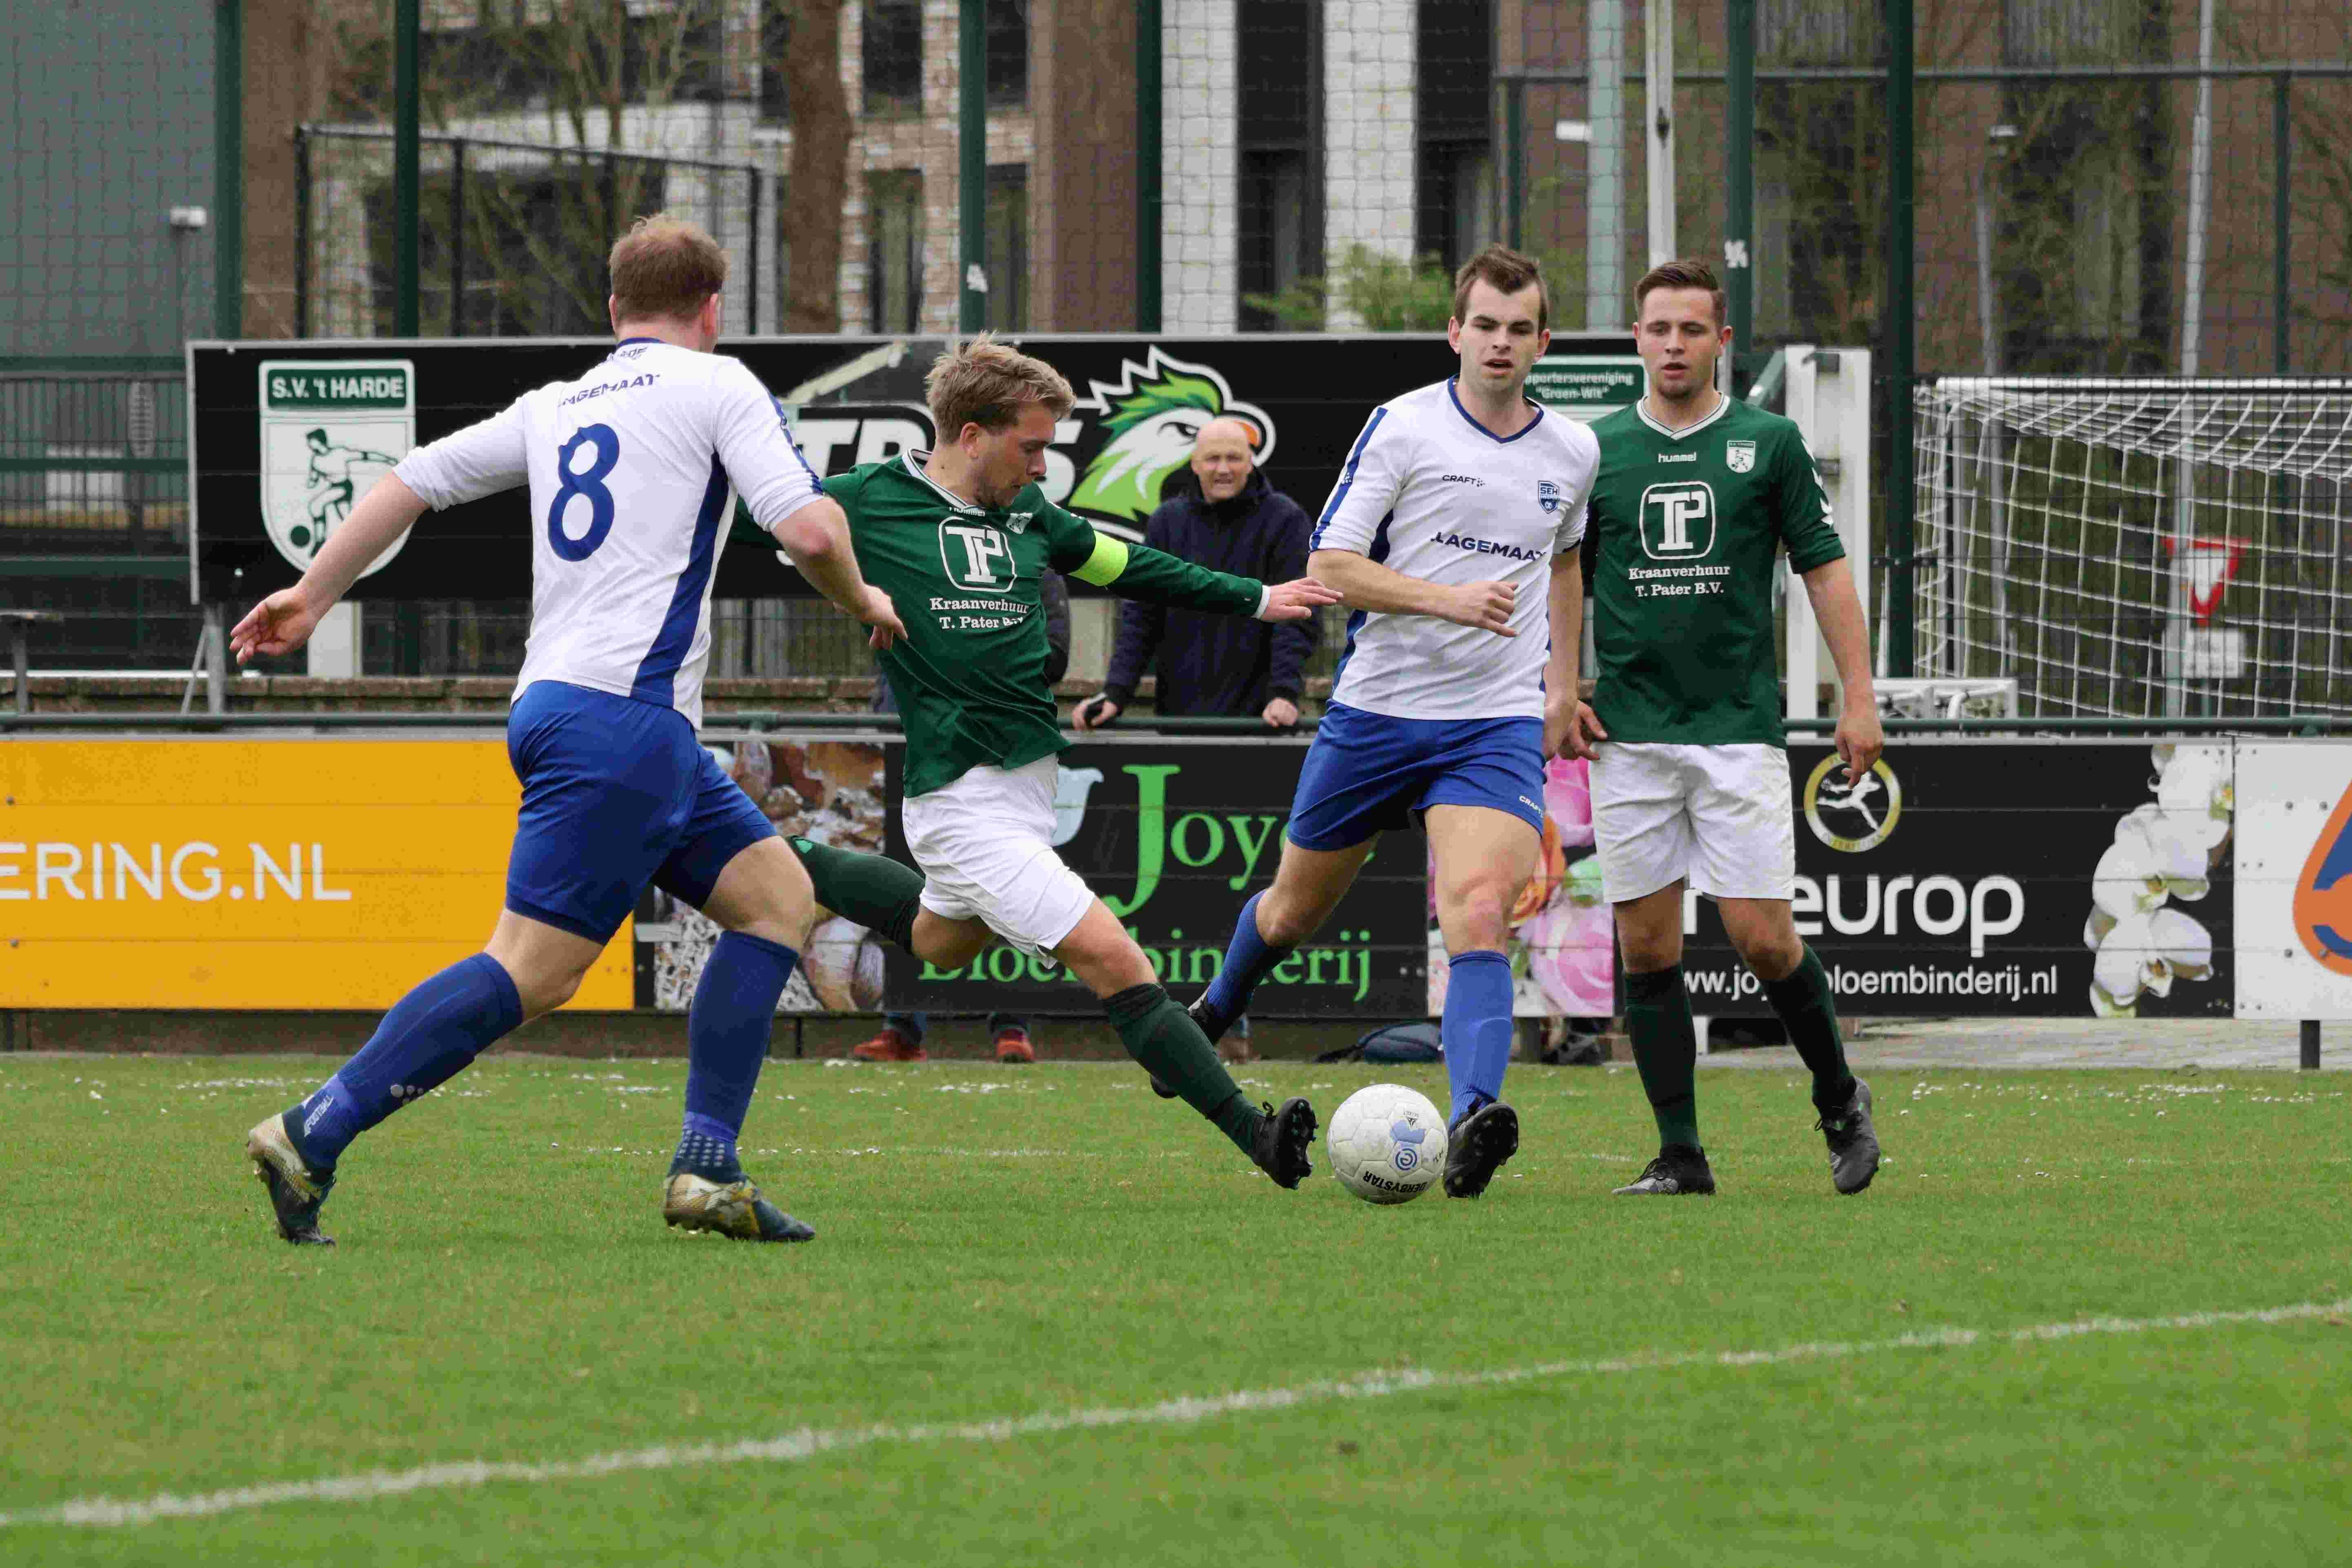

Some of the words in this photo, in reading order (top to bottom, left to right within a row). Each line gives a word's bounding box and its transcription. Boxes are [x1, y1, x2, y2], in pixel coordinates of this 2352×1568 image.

[272, 375, 310, 399] S.V.
[330, 376, 405, 399] HARDE
[1658, 452, 1697, 463] hummel
[1442, 474, 1477, 485] CRAFT
[547, 423, 620, 562] 8
[1540, 487, 1558, 495] SEH
[1628, 565, 1730, 580] Kraanverhuur
[1635, 585, 1648, 597] T.
[1650, 584, 1692, 596] Pater
[1694, 581, 1725, 595] B.V.
[929, 597, 1030, 614] Kraanverhuur
[939, 616, 956, 629] T.
[959, 616, 999, 629] Pater
[0, 842, 353, 901] ERING.NL
[1362, 1170, 1428, 1193] DERBYSTAR
